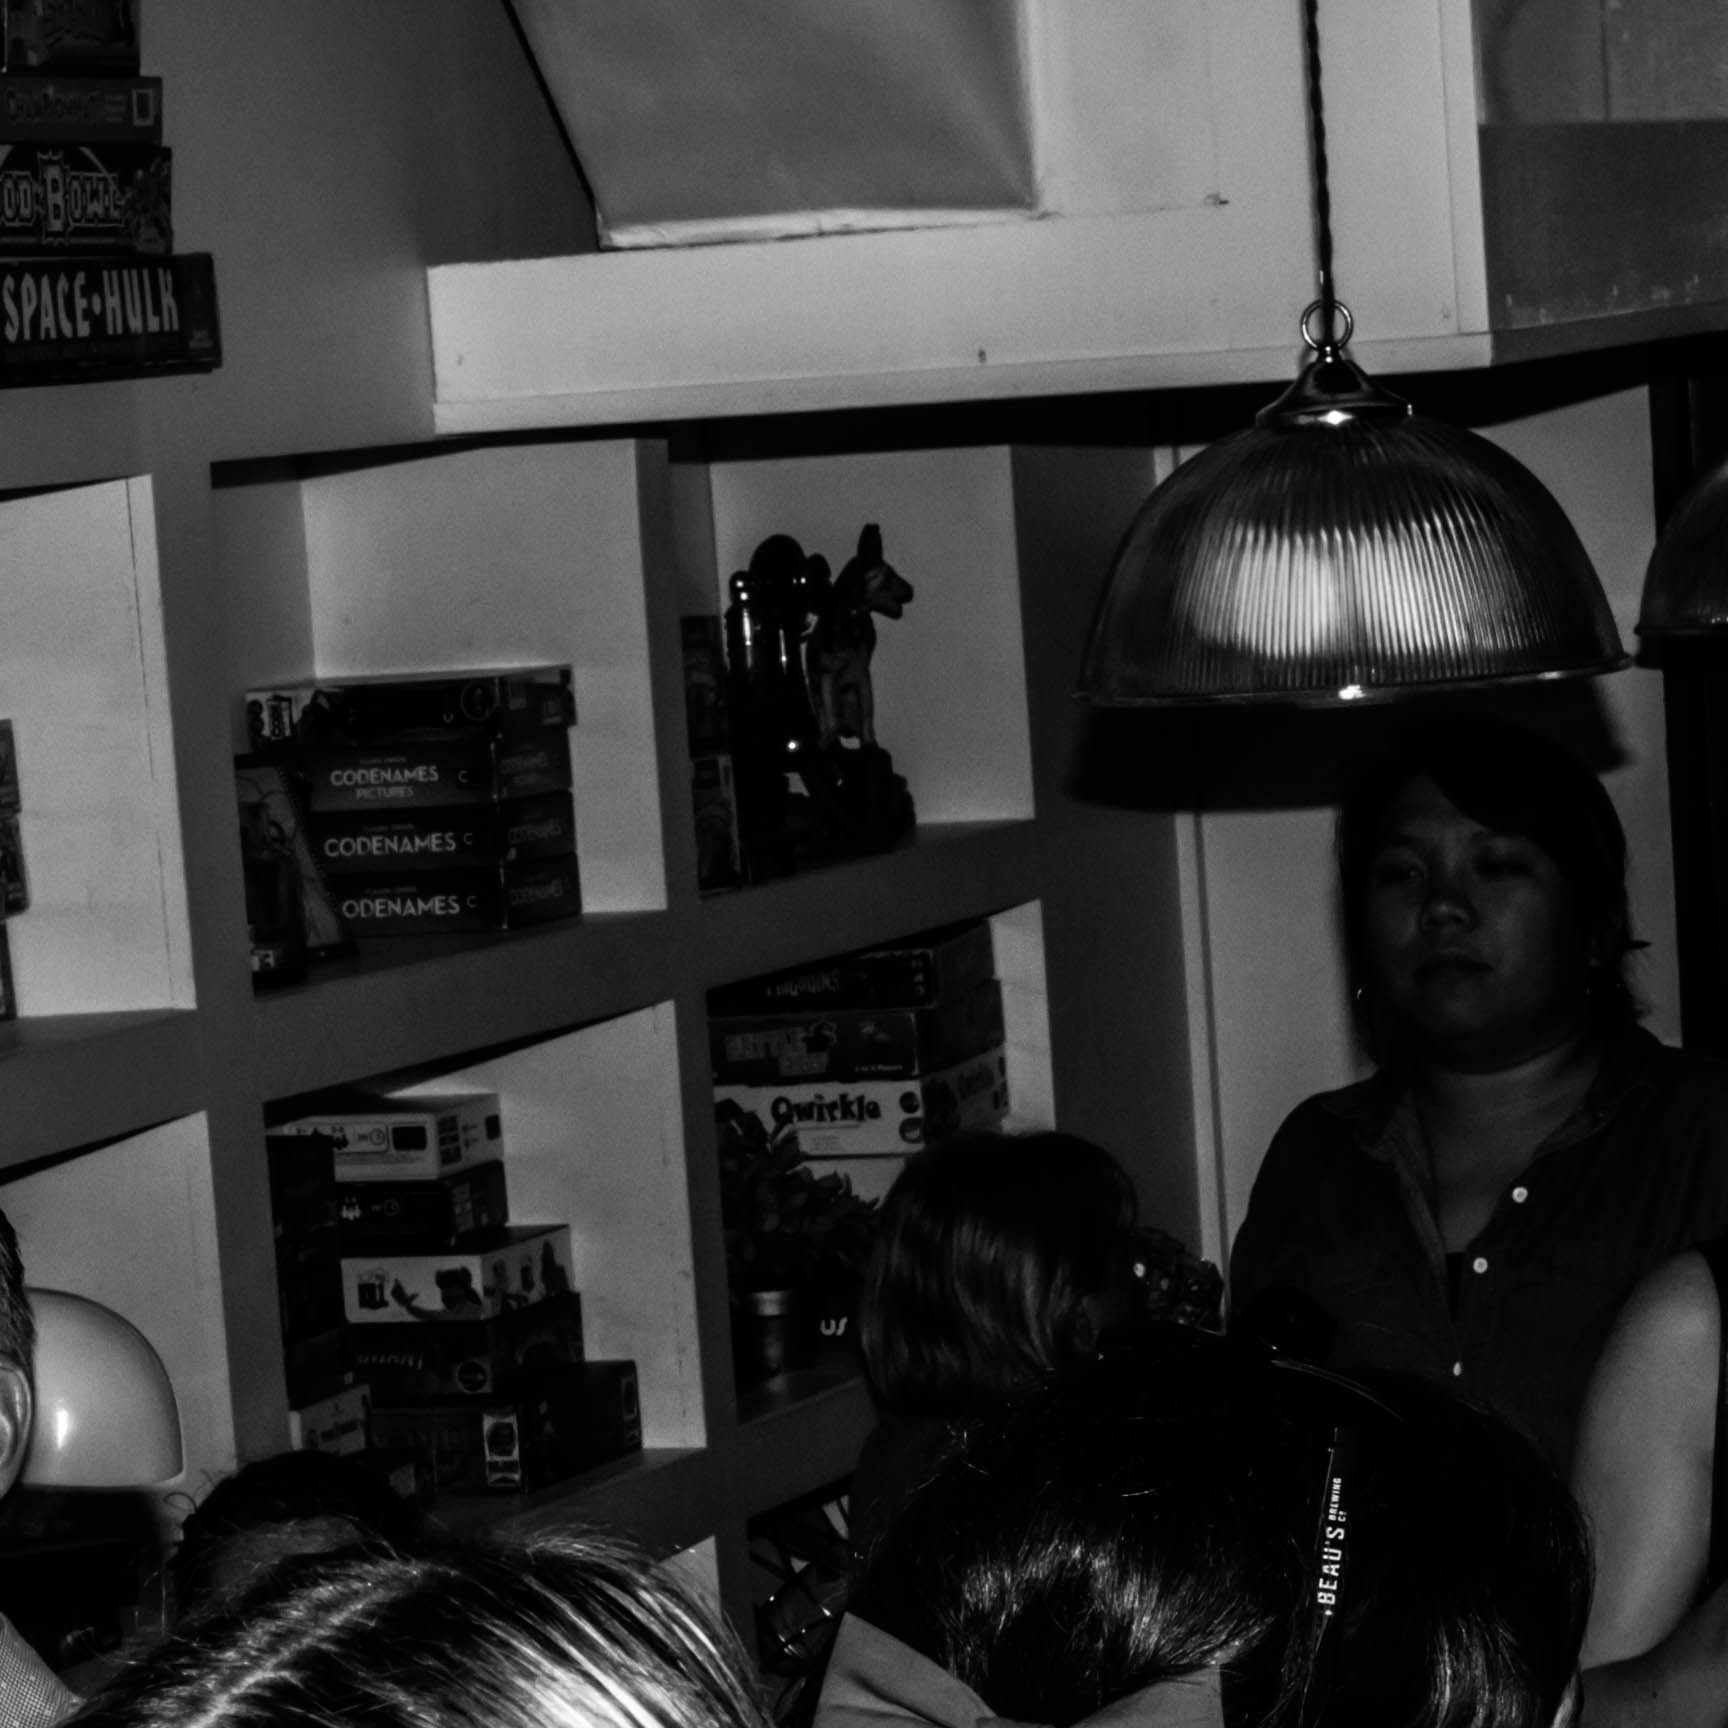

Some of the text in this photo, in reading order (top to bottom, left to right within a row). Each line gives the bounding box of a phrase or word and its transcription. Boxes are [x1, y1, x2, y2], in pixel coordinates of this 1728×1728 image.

[329, 765, 440, 787] CODENAMES
[323, 831, 458, 858] CODENAMES
[340, 894, 461, 919] ODENAMES
[771, 1093, 882, 1131] Qwirkle
